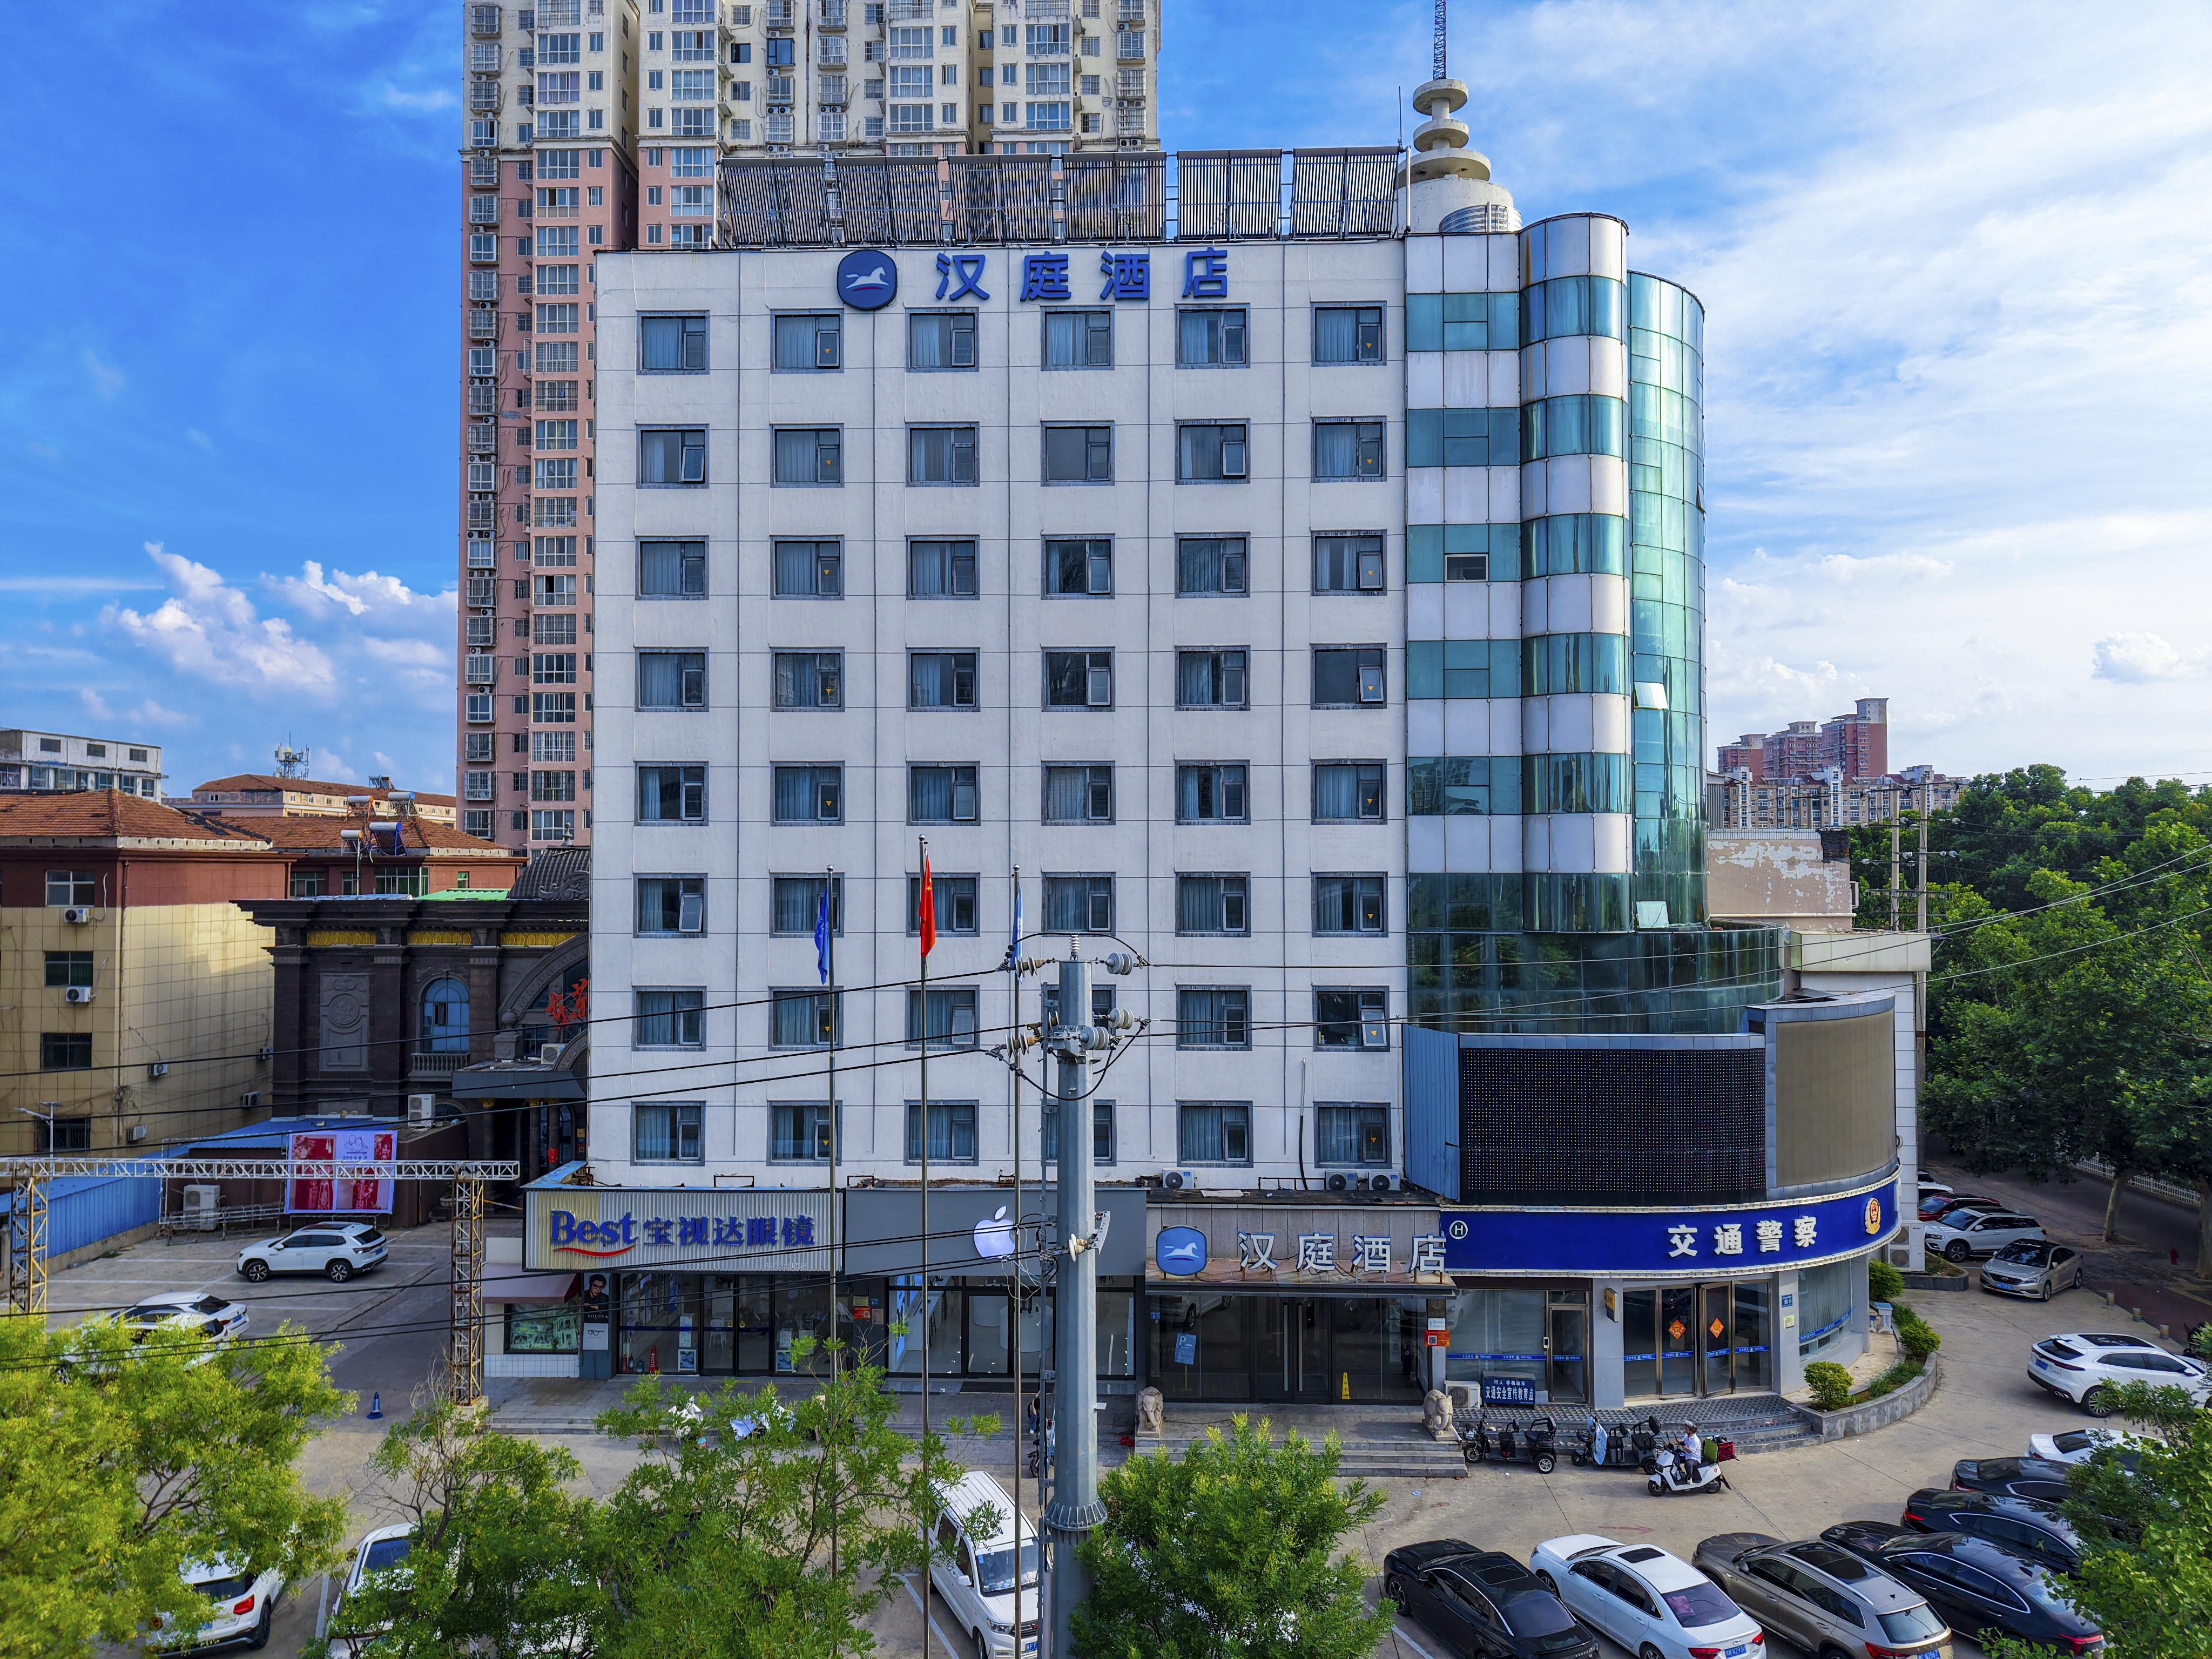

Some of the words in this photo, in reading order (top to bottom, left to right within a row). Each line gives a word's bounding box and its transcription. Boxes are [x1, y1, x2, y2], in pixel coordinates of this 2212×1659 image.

[935, 247, 1229, 302] 汉庭酒店
[551, 1210, 637, 1244] Best
[643, 1214, 814, 1246] 宝视达眼镜
[1668, 1215, 1818, 1258] 交通警察
[1238, 1231, 1447, 1273] 汉庭酒店
[1179, 1335, 1186, 1346] P
[1486, 1386, 1534, 1401] 交通安全宣传教育点
